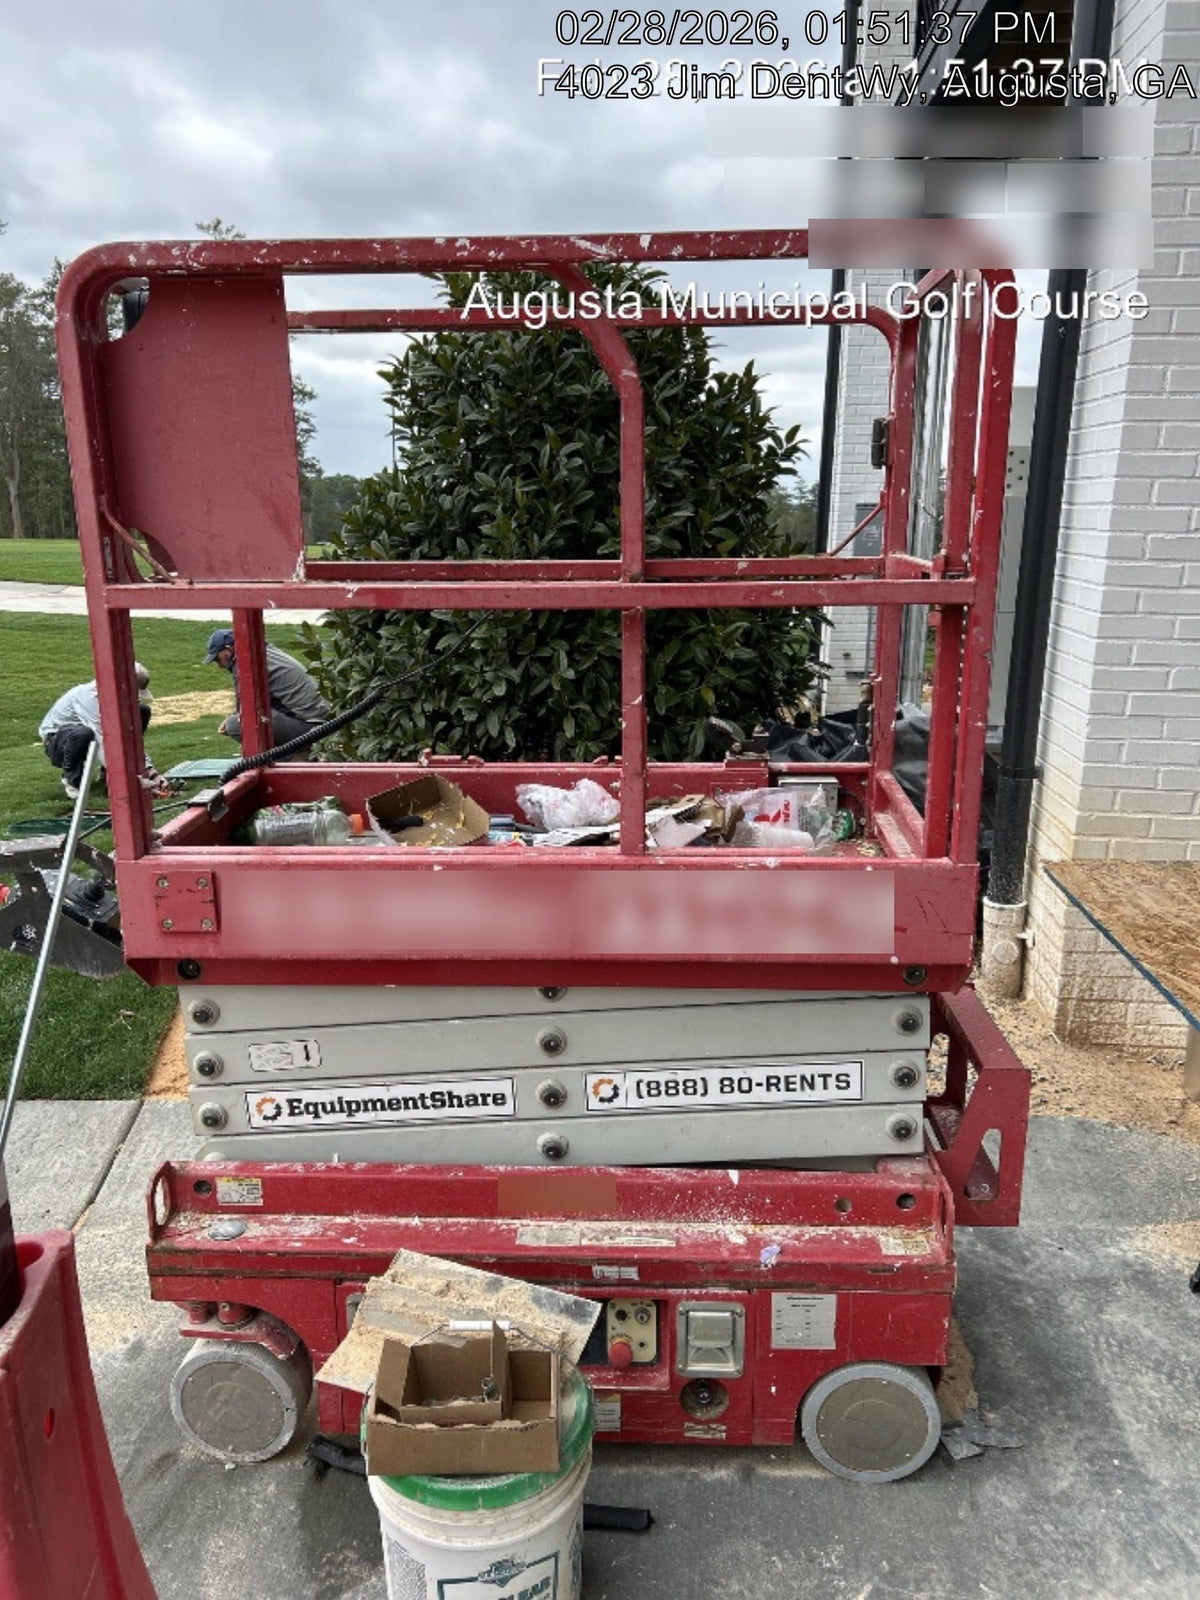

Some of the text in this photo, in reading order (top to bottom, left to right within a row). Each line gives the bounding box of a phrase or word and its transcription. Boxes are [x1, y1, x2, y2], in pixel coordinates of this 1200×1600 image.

[636, 1073, 852, 1099] (888) 80-RENTS
[286, 1089, 507, 1119] EquipmentShare
